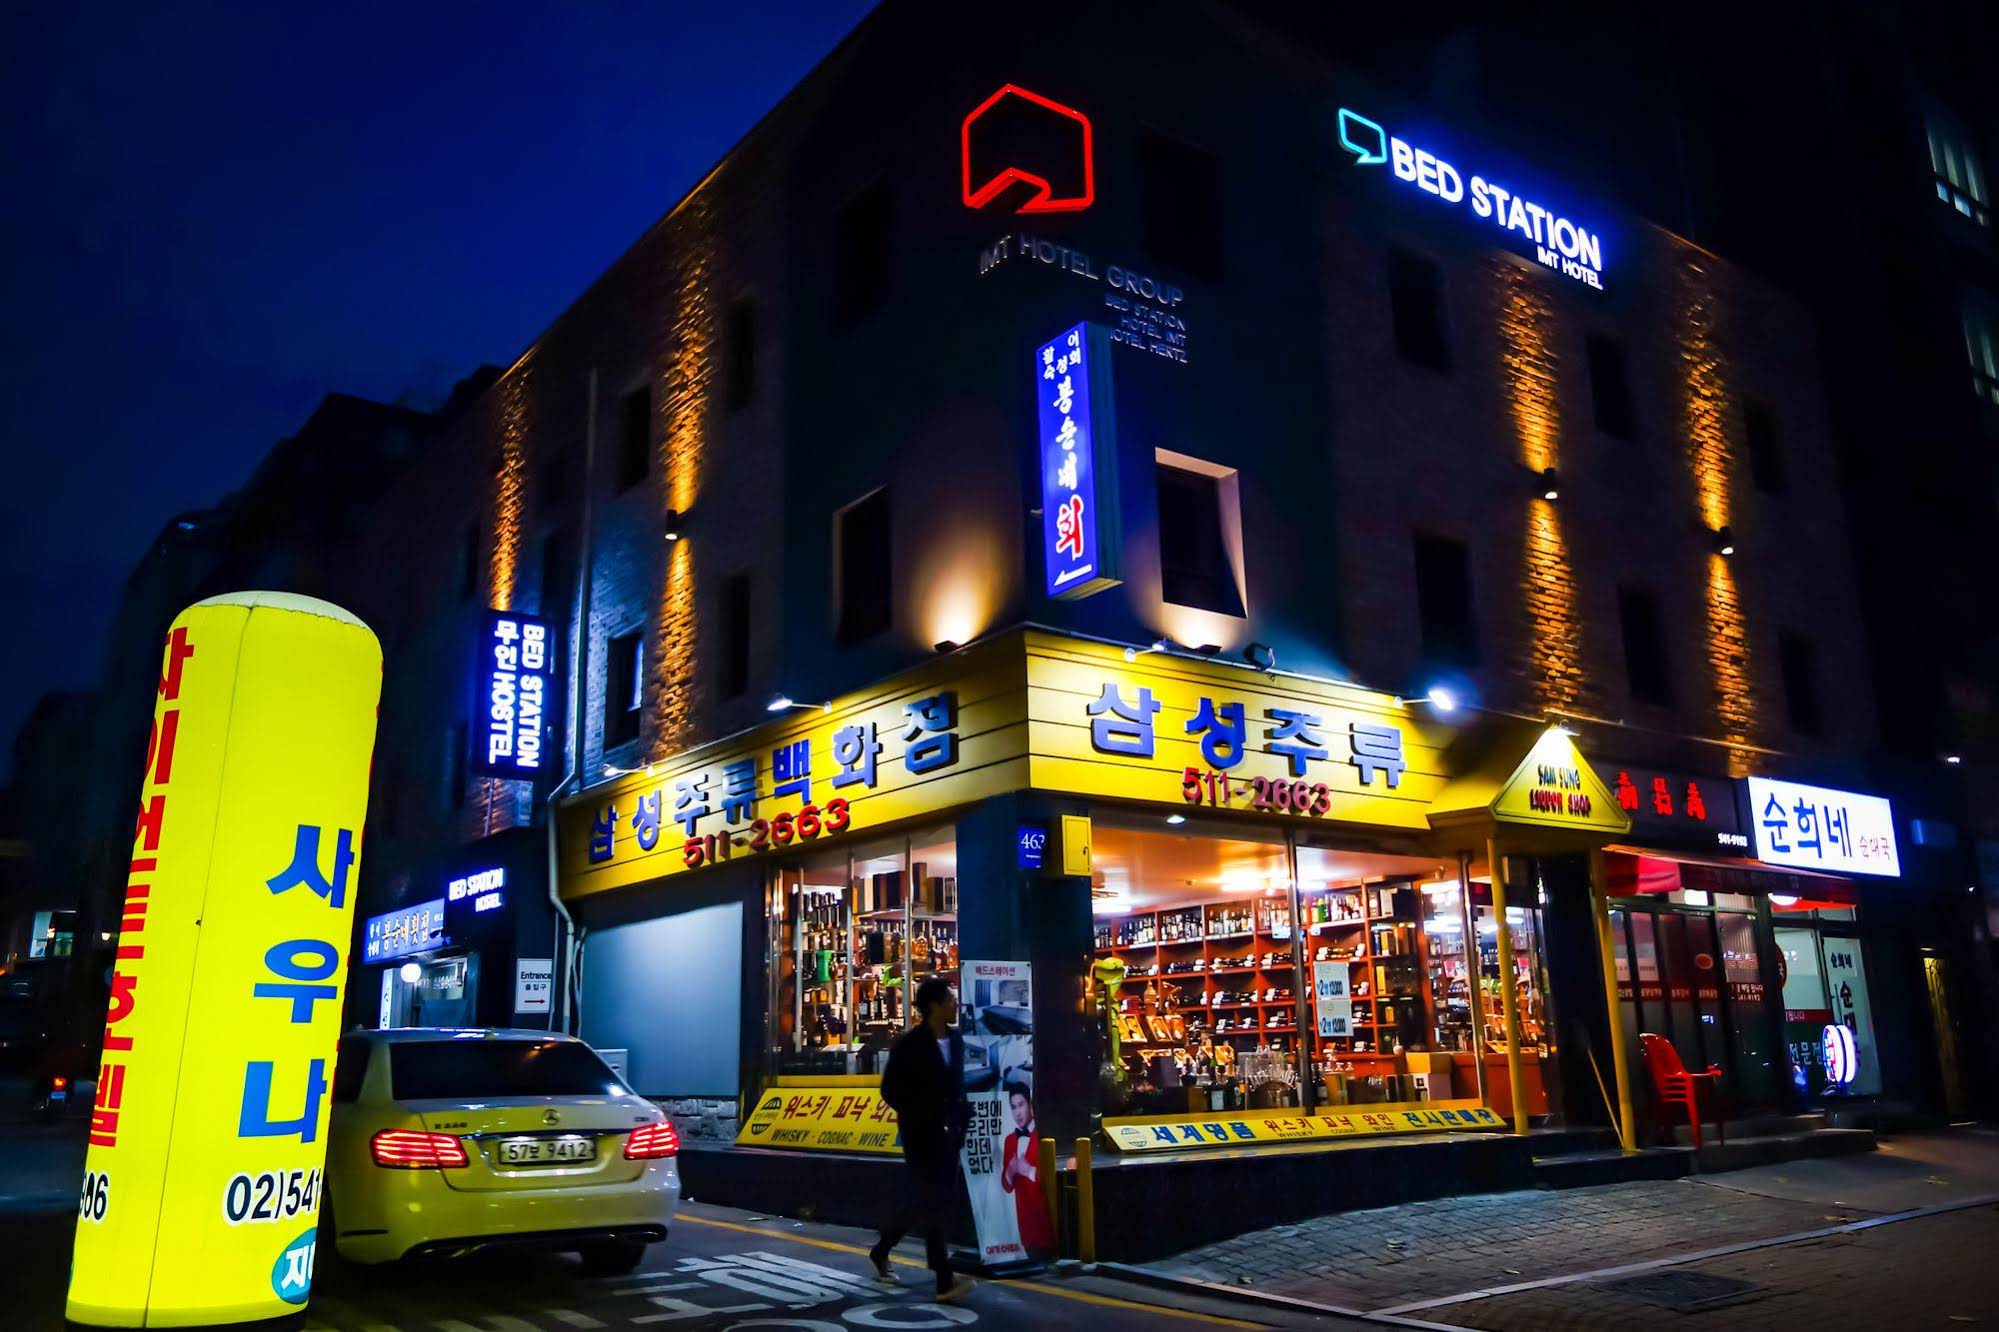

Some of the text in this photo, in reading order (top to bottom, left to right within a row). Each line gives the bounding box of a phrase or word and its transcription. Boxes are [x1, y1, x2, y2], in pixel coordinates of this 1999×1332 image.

[1391, 136, 1602, 271] BED STATION
[979, 233, 1184, 307] IMT HOTEL GROUP
[1537, 245, 1604, 290] IMT HOTEL
[1105, 292, 1186, 332] BED STATION
[1121, 317, 1187, 347] HOTEL IMT
[1150, 342, 1188, 363] HERTZ
[516, 624, 545, 768] BED STATION
[1086, 682, 1406, 787] 삼성주류
[1183, 767, 1332, 815] 511-2663
[1530, 788, 1563, 815] LIQUOR
[1568, 793, 1591, 818] SHOP
[683, 797, 851, 867] 511-2663
[1763, 793, 1892, 861] 순희네 순대국
[238, 824, 355, 1144] 사우나
[520, 971, 552, 980] Entrance
[782, 1096, 832, 1120] 위스키
[770, 1128, 891, 1146] WHISKY COGNAC WINE
[1150, 1121, 1257, 1145] 세계명품
[1264, 1117, 1315, 1133] 위스키
[1362, 1112, 1394, 1127] 와인
[1278, 1129, 1314, 1139] WHISKY
[1373, 1125, 1397, 1133] WINE
[547, 1141, 588, 1159] 9412
